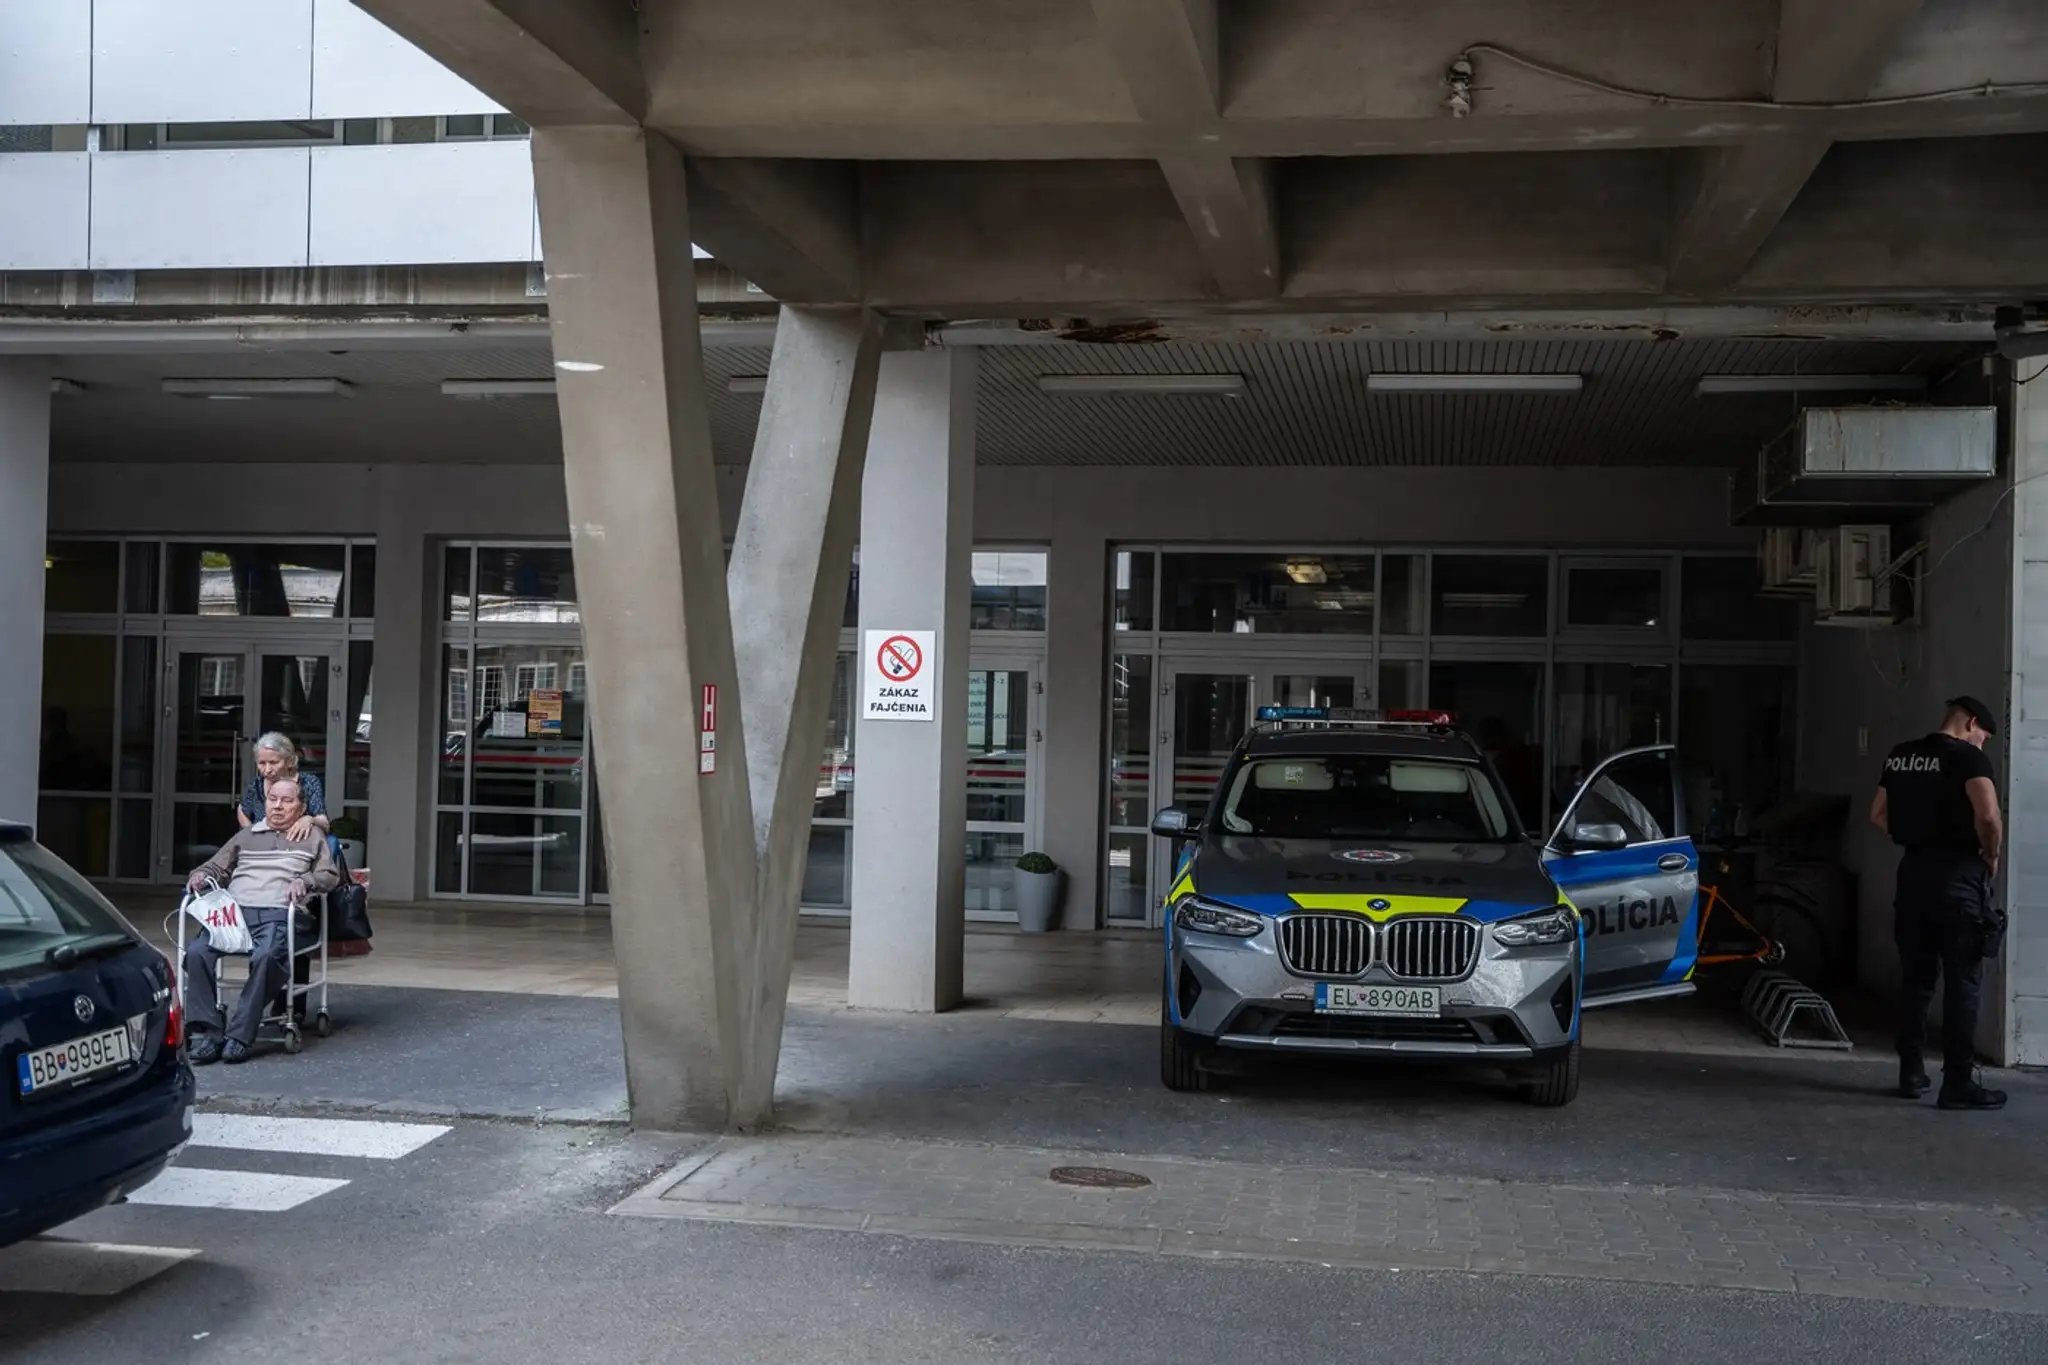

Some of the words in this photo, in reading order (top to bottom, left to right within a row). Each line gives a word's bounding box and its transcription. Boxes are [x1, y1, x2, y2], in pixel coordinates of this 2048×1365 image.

[879, 687, 919, 697] ZÁKAZ
[870, 702, 927, 712] FAJČENIA
[1885, 753, 1940, 771] POLÍCIA
[1580, 896, 1679, 939] OLÍCIA
